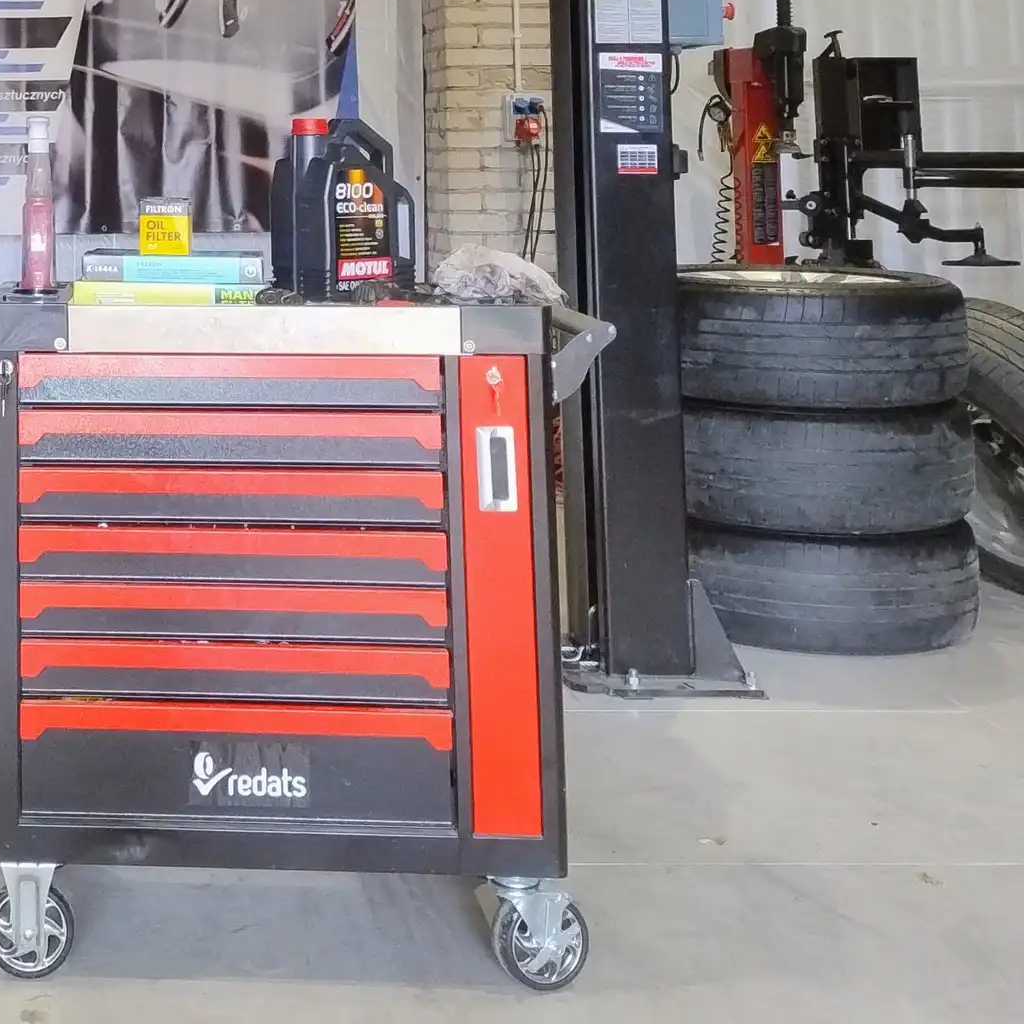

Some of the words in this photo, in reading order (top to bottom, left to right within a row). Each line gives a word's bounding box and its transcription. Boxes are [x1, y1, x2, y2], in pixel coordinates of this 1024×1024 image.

[335, 182, 374, 200] 8100
[145, 204, 183, 215] FILTRON
[146, 219, 165, 231] OIL
[146, 231, 182, 242] FILTER
[340, 260, 390, 277] MOTUL
[227, 767, 307, 798] redats
